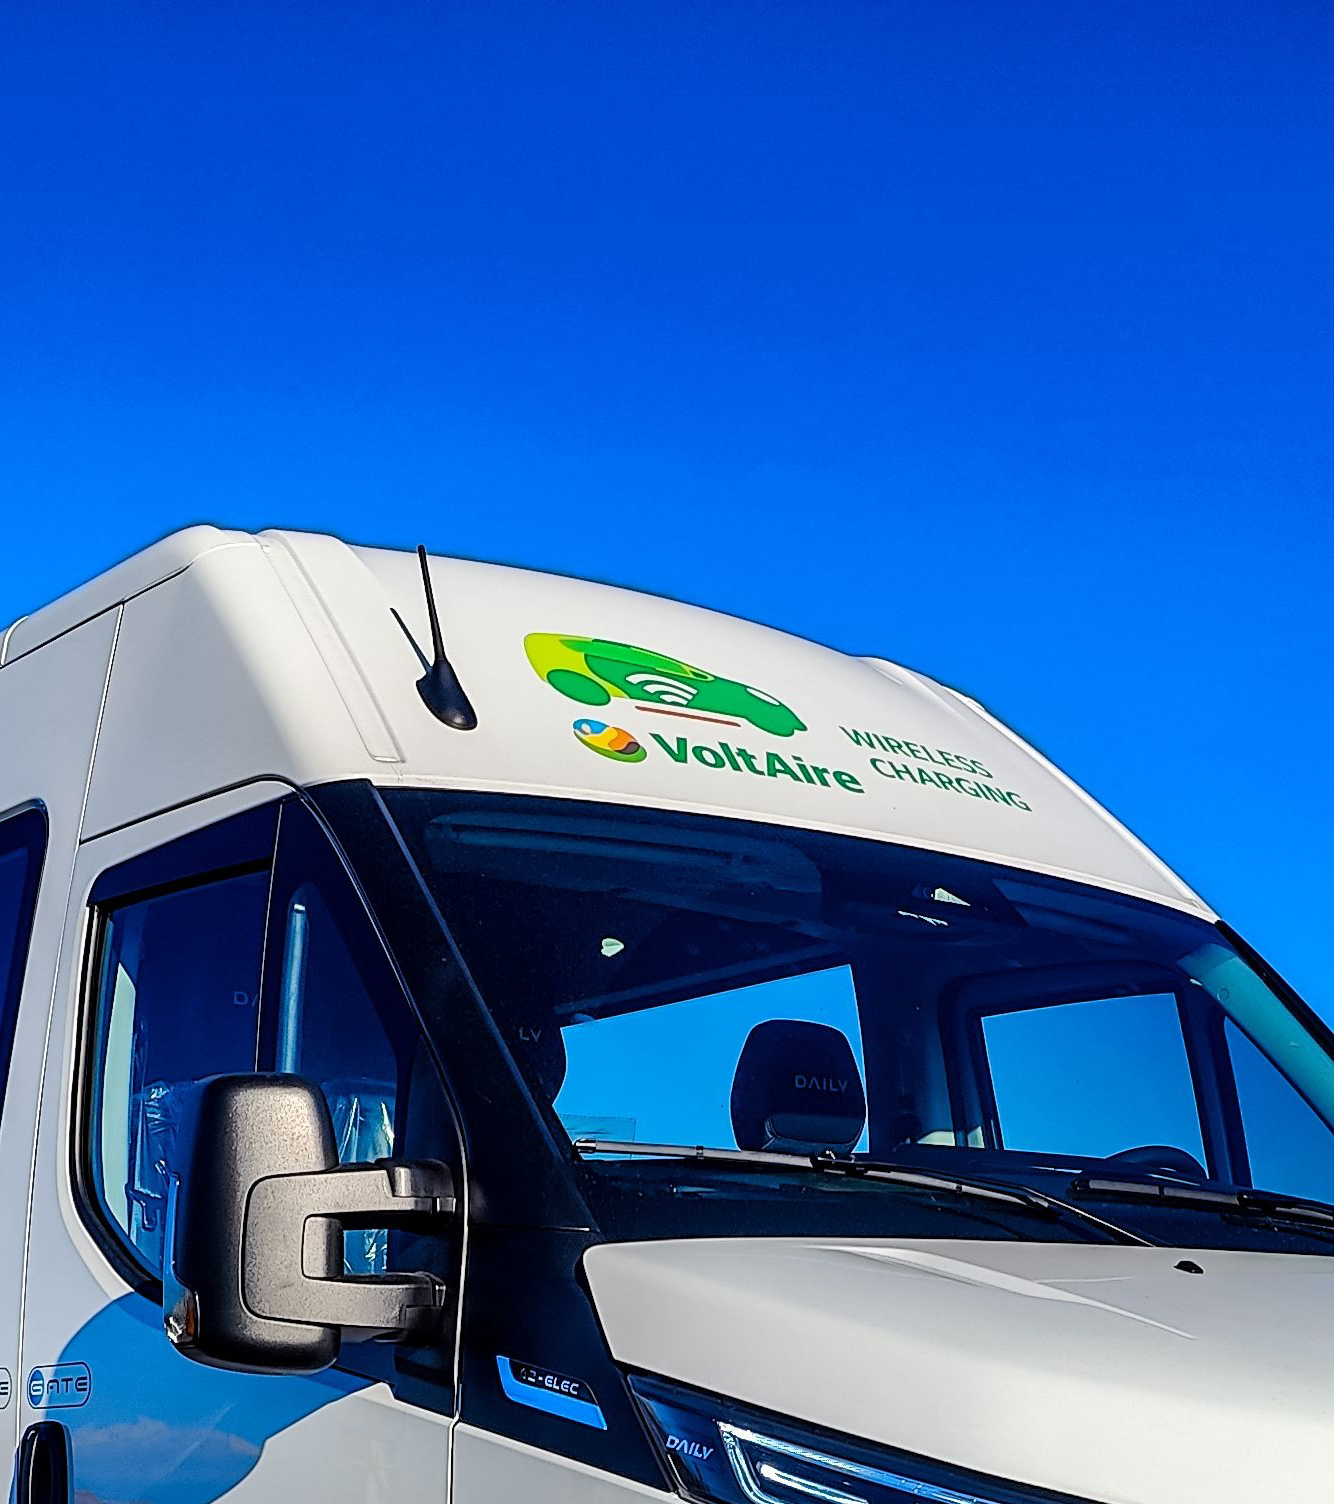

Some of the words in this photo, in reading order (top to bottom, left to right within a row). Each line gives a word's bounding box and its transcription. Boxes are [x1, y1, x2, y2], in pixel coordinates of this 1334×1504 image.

[650, 731, 866, 794] VoltAire
[838, 725, 994, 779] WIRELESS
[870, 757, 1033, 812] CHARGING
[666, 1435, 714, 1460] DAILY
